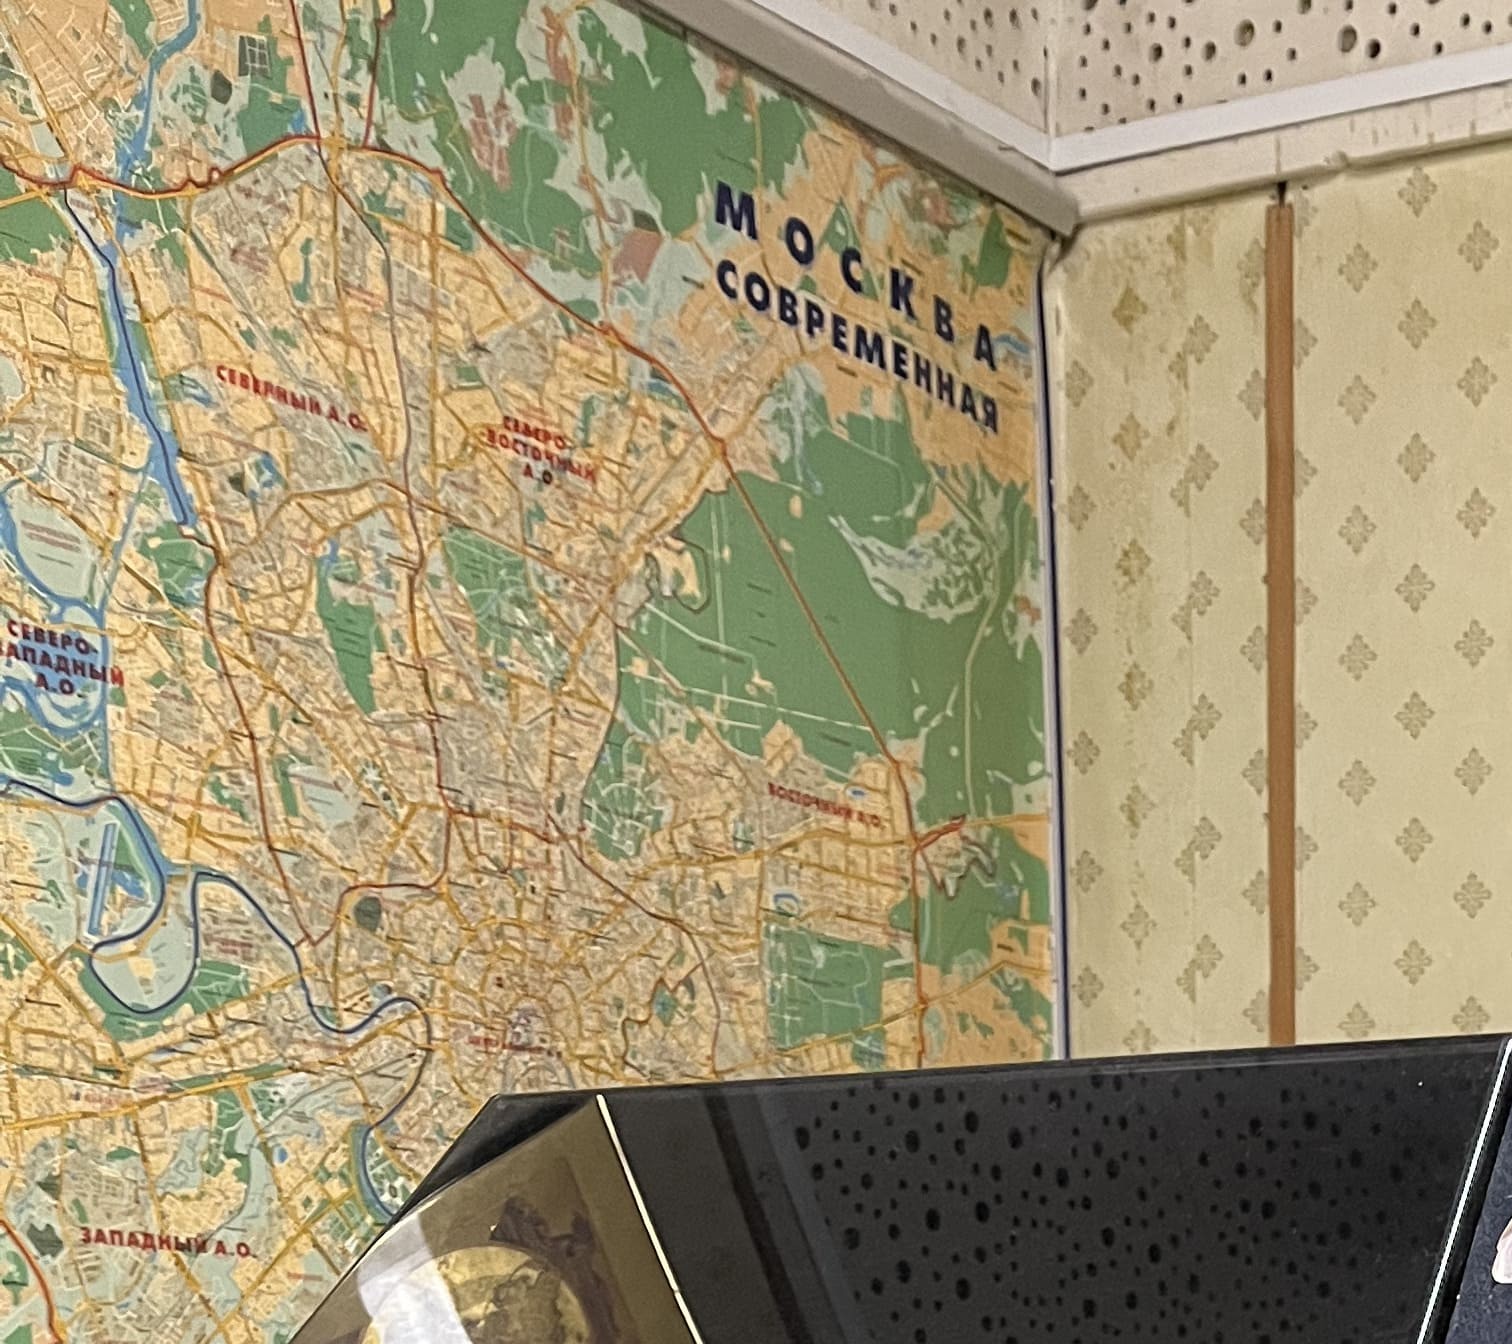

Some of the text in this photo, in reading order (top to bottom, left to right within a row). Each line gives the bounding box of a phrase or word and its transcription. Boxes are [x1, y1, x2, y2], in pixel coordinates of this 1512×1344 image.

[713, 180, 997, 372] МОСКВА
[716, 257, 999, 435] СОВРЕМЕННАЯ
[81, 1227, 208, 1253] ЗАПАДНЫЙ
